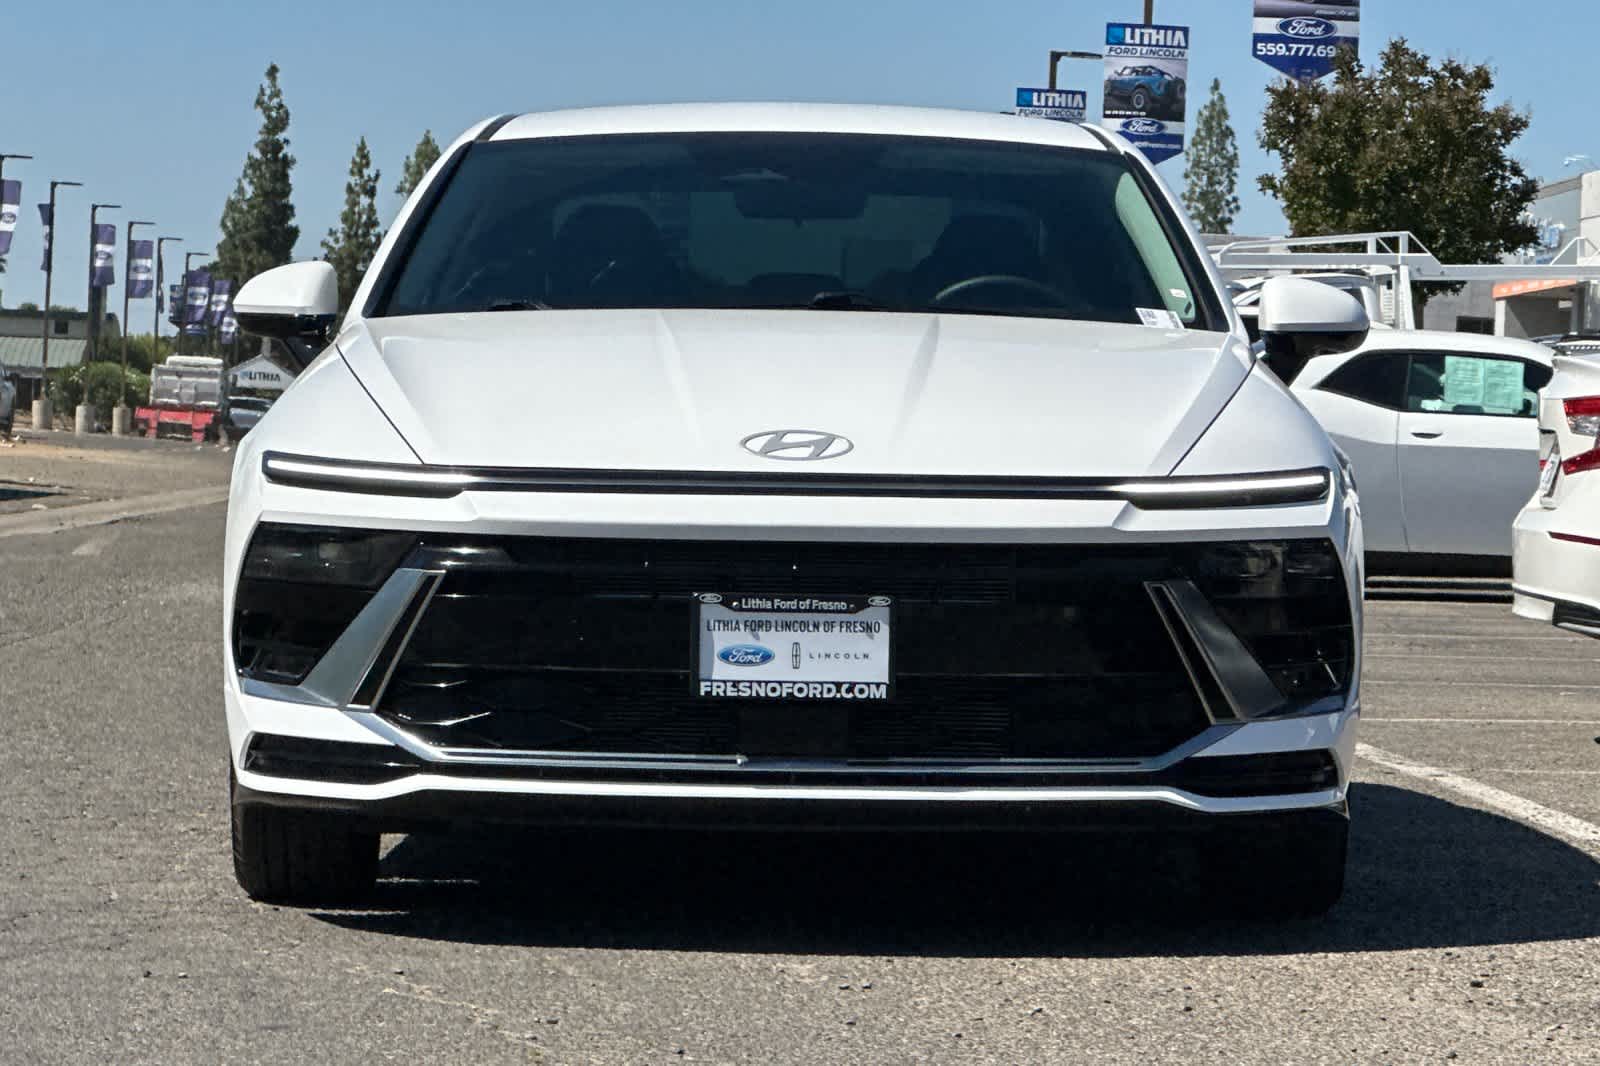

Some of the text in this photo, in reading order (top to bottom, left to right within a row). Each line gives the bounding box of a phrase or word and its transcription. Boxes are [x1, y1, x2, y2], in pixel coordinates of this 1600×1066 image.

[1288, 20, 1326, 35] Ford
[1125, 28, 1186, 46] LITHIA
[1108, 46, 1185, 57] FORD LINCOLN
[1256, 43, 1341, 57] 559.777.69
[1032, 92, 1084, 108] LITHIA
[1018, 108, 1084, 118] FORD LINCOLN
[1129, 119, 1158, 133] Ford
[741, 598, 847, 610] Lithia Ford of Fresno
[706, 620, 881, 633] LITHIA FORD LINCOLN OF FRESNO
[728, 648, 762, 664] Ford
[809, 652, 870, 660] LINCOLN
[700, 681, 888, 699] FRESNOFORD.COM
